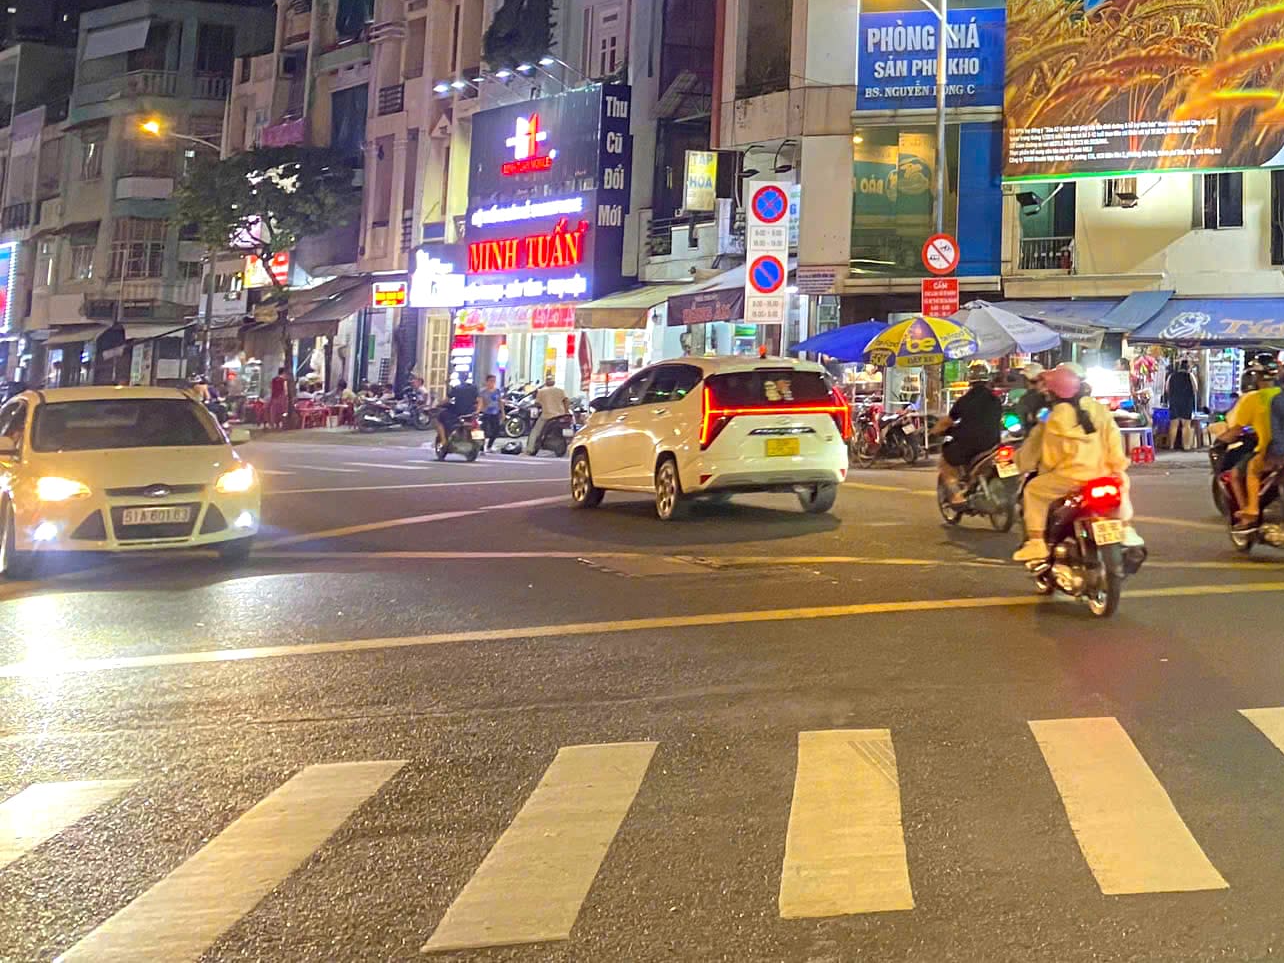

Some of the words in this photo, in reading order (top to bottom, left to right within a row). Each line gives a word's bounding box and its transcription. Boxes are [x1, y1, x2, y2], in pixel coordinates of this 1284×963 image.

[867, 20, 935, 53] PHÒNG
[874, 55, 908, 78] SẢN
[948, 58, 979, 75] KHO
[606, 96, 628, 118] Thu
[606, 132, 623, 153] Cũ
[604, 164, 625, 190] Đổi
[598, 204, 622, 227] Mới
[468, 239, 519, 273] MINH
[525, 218, 584, 269] TUẤN
[906, 335, 937, 353] be
